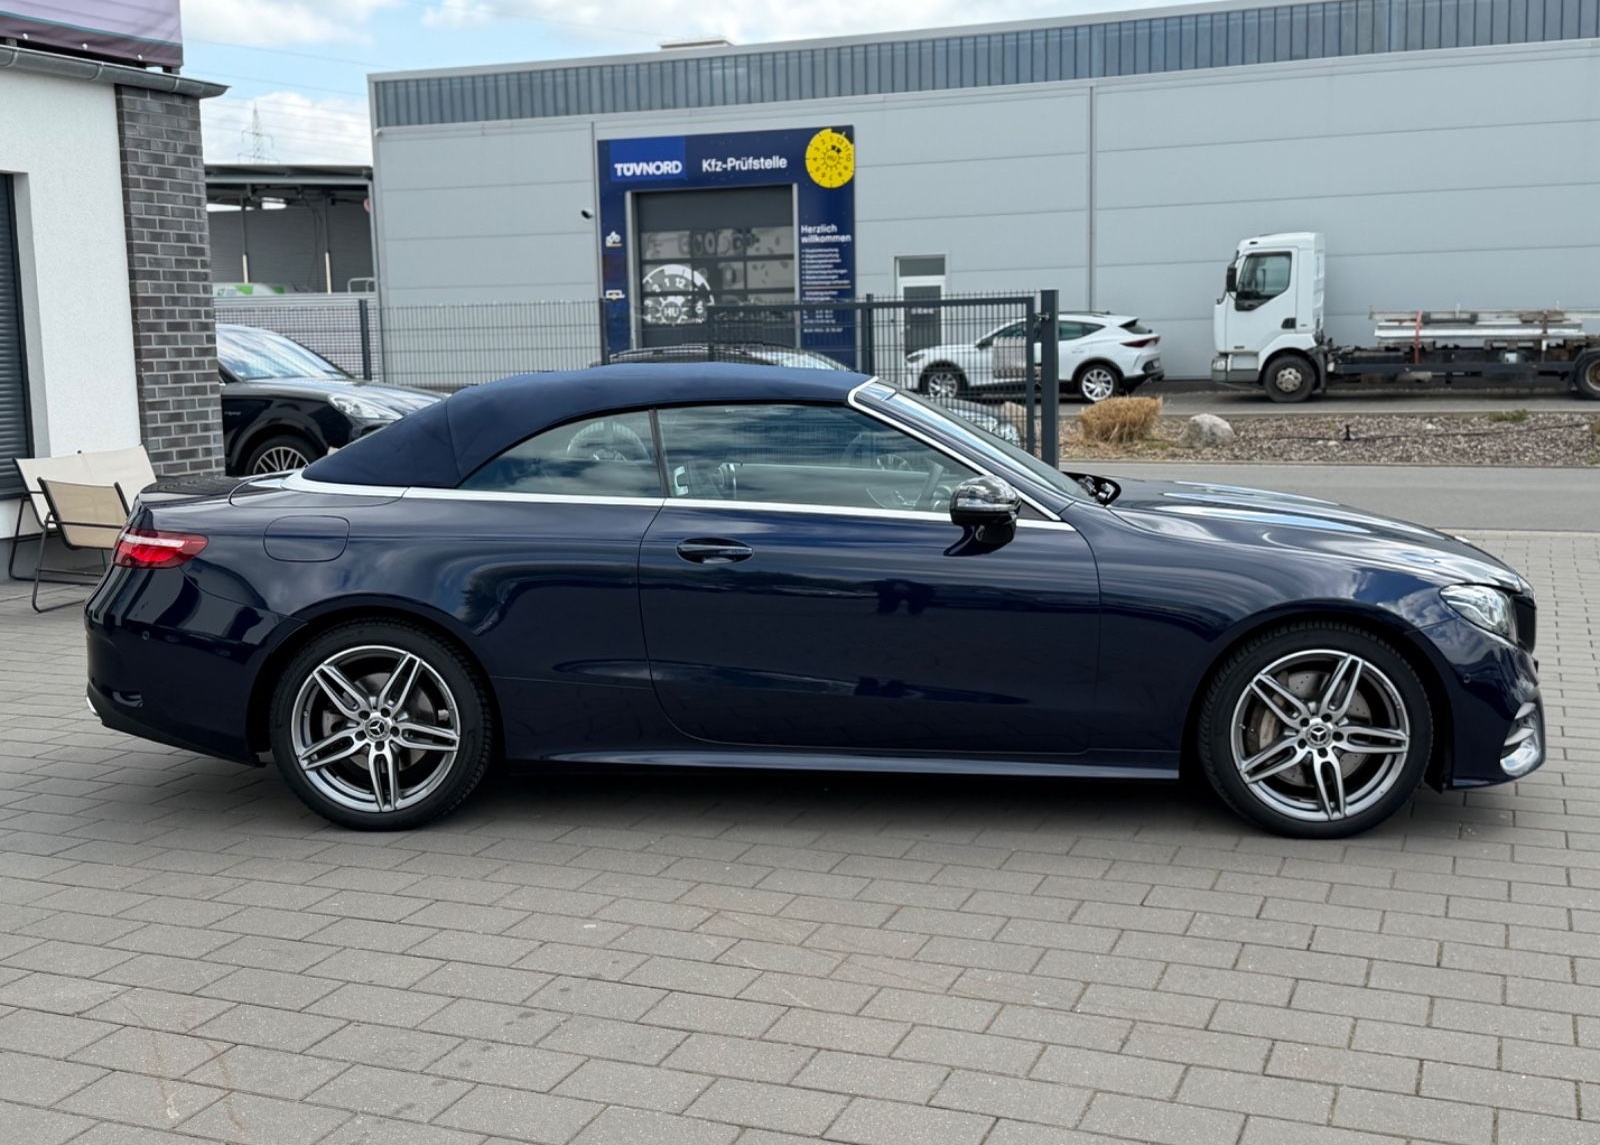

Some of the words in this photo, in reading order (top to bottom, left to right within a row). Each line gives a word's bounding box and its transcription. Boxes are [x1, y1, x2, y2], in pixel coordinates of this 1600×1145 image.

[701, 155, 788, 173] Kfz-Prüfstelle
[800, 224, 838, 234] Herzlich
[800, 234, 852, 244] willkommen
[663, 307, 679, 318] HU
